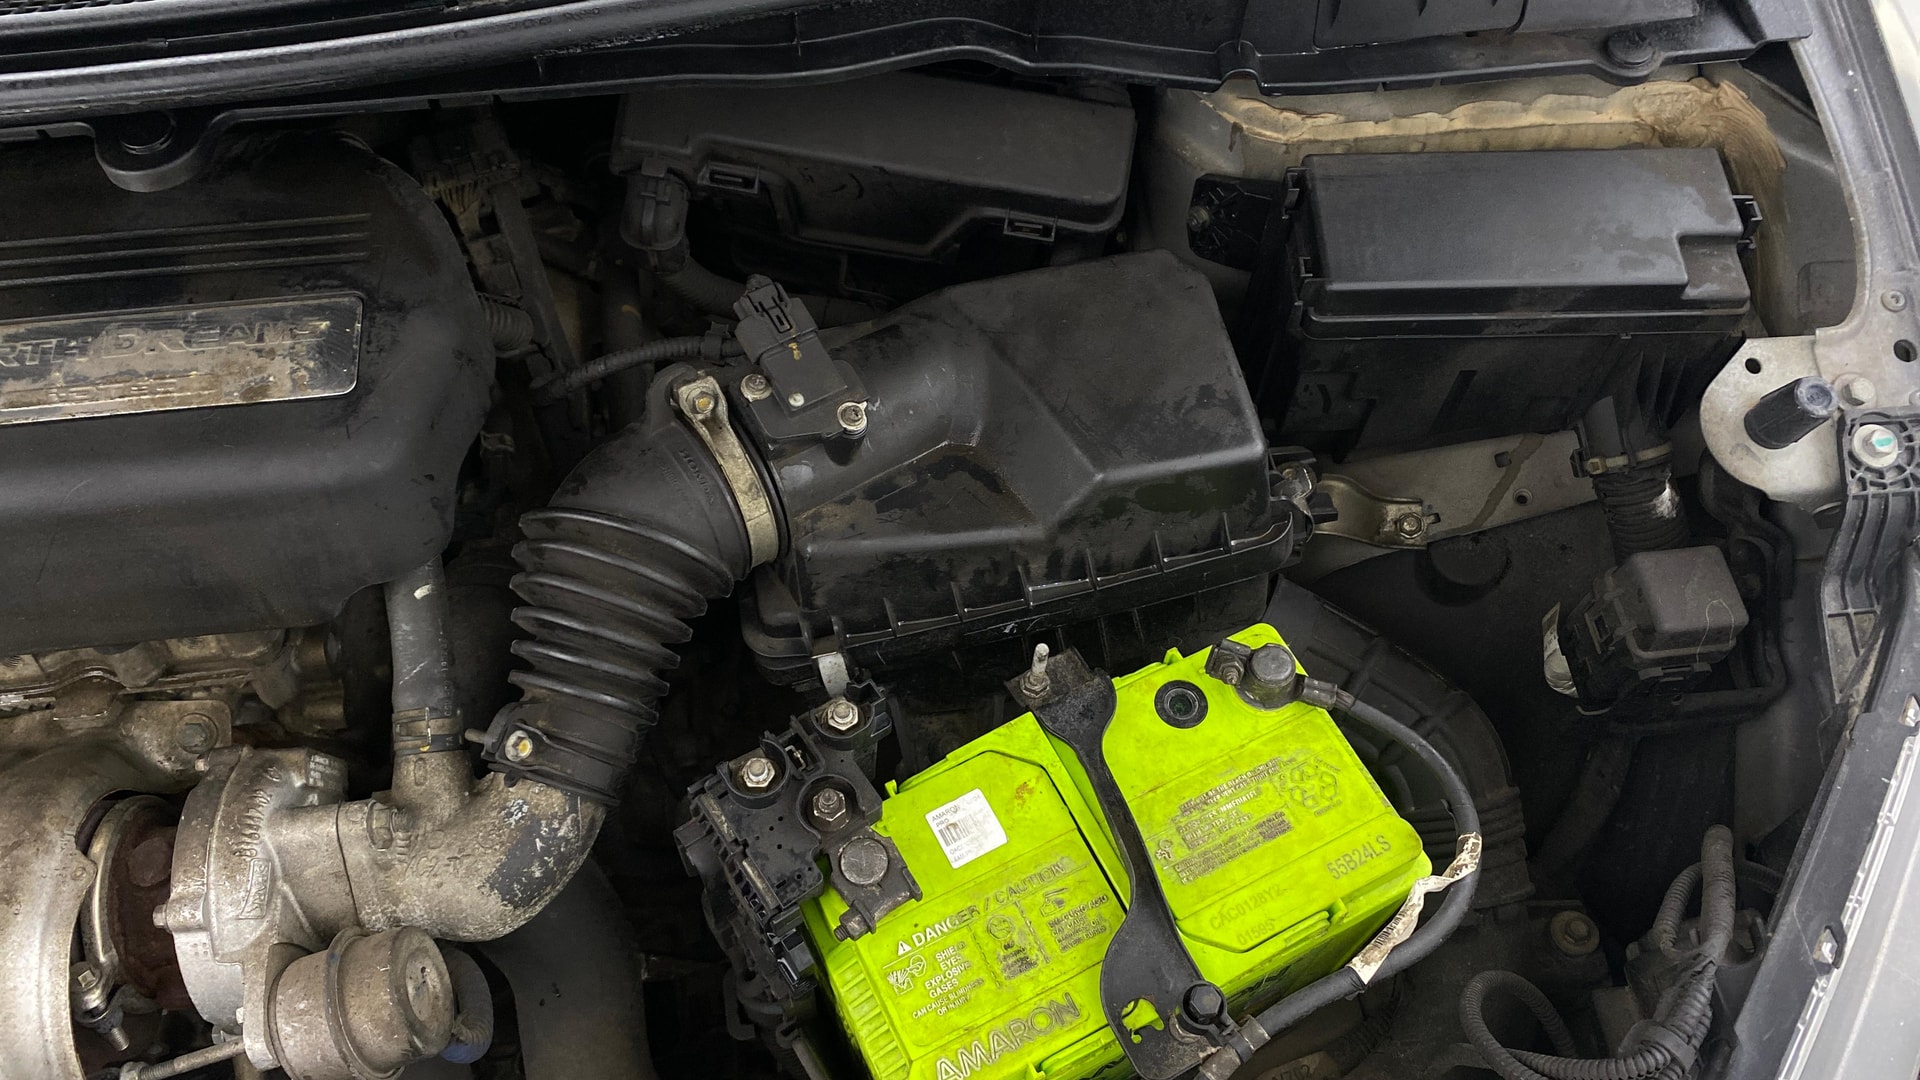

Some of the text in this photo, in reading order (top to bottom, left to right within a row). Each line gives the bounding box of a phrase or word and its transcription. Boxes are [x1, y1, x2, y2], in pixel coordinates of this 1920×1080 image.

[1325, 831, 1393, 882] 55B24LS
[910, 902, 982, 948] DANGER
[993, 861, 1067, 907] CAUTION
[923, 959, 972, 990] EXPLOSIVE
[938, 952, 964, 972] EYES
[927, 976, 960, 999] GASES
[926, 994, 950, 1013] CAUSE
[935, 1004, 948, 1017] OR
[934, 992, 1081, 1080] AMARON
